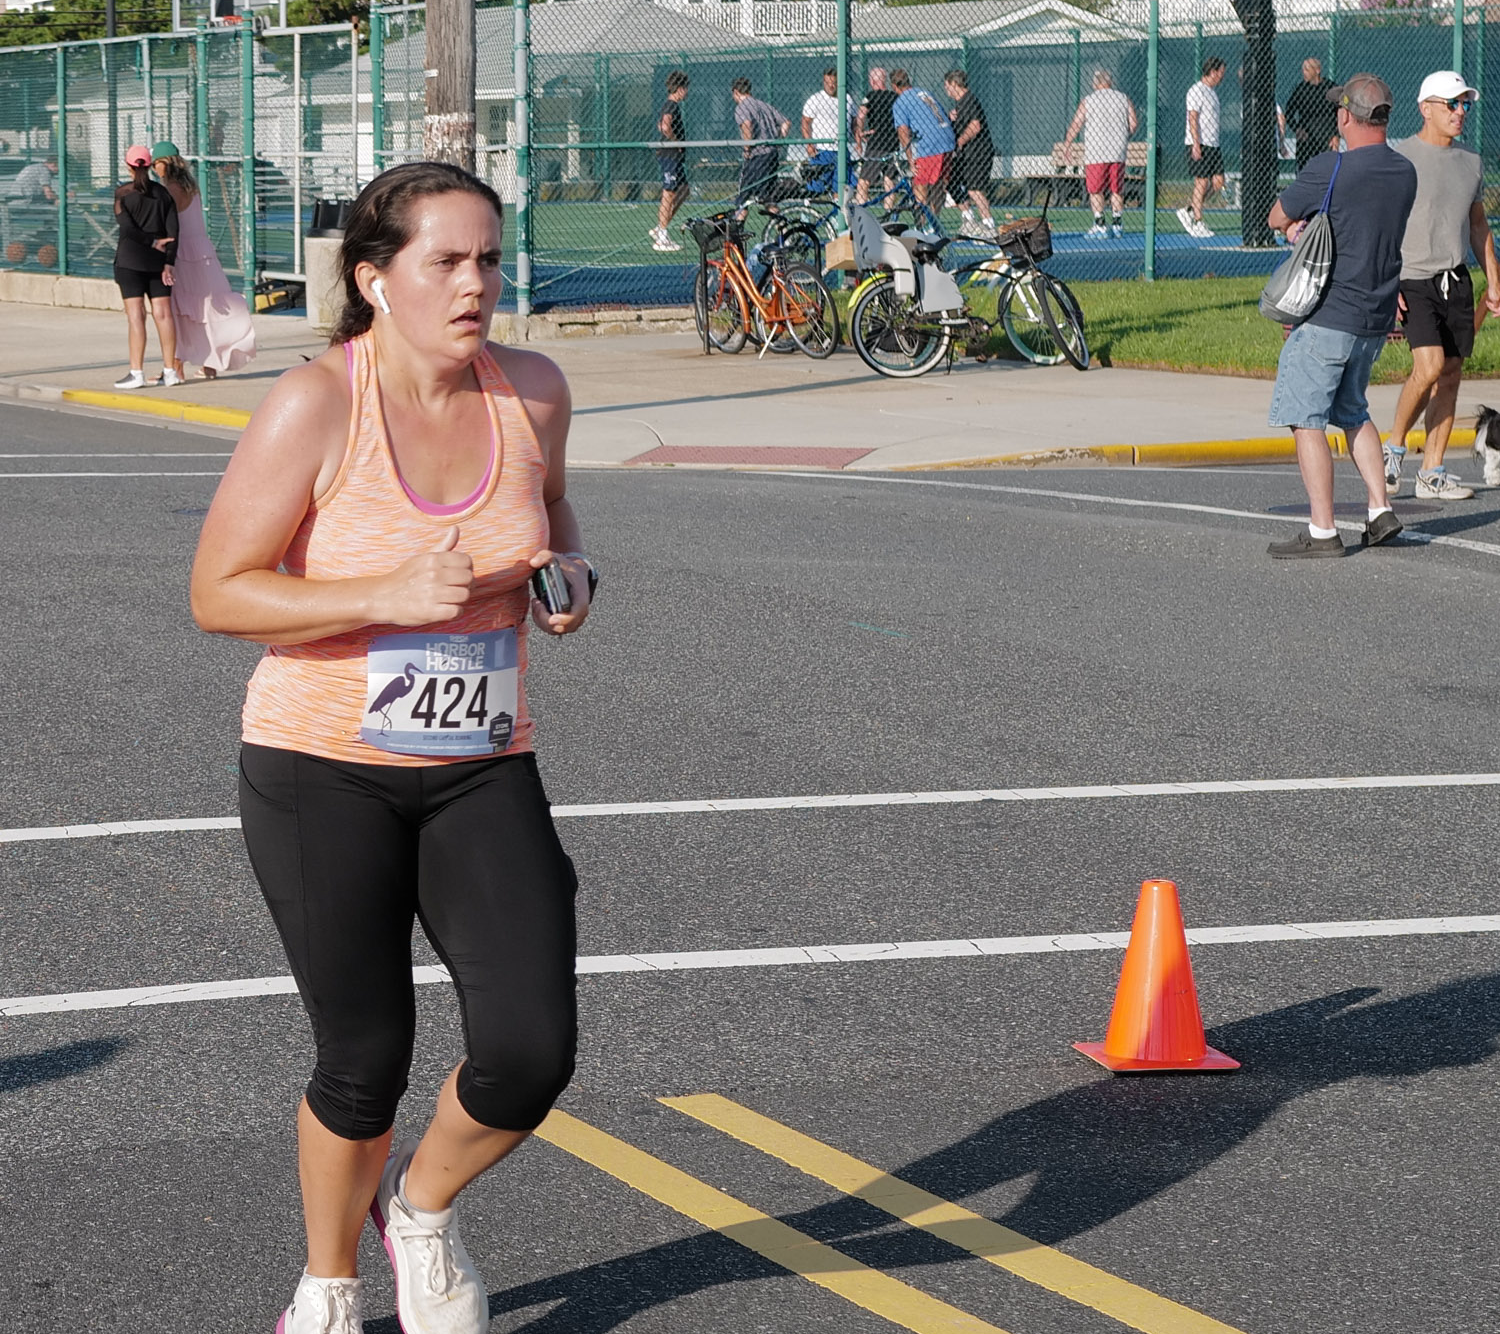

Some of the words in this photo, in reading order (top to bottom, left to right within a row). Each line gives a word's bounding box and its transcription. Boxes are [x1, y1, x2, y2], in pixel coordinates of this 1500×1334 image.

[426, 643, 485, 657] HARBOR
[426, 656, 484, 671] HUSTLE
[411, 675, 488, 728] 424
